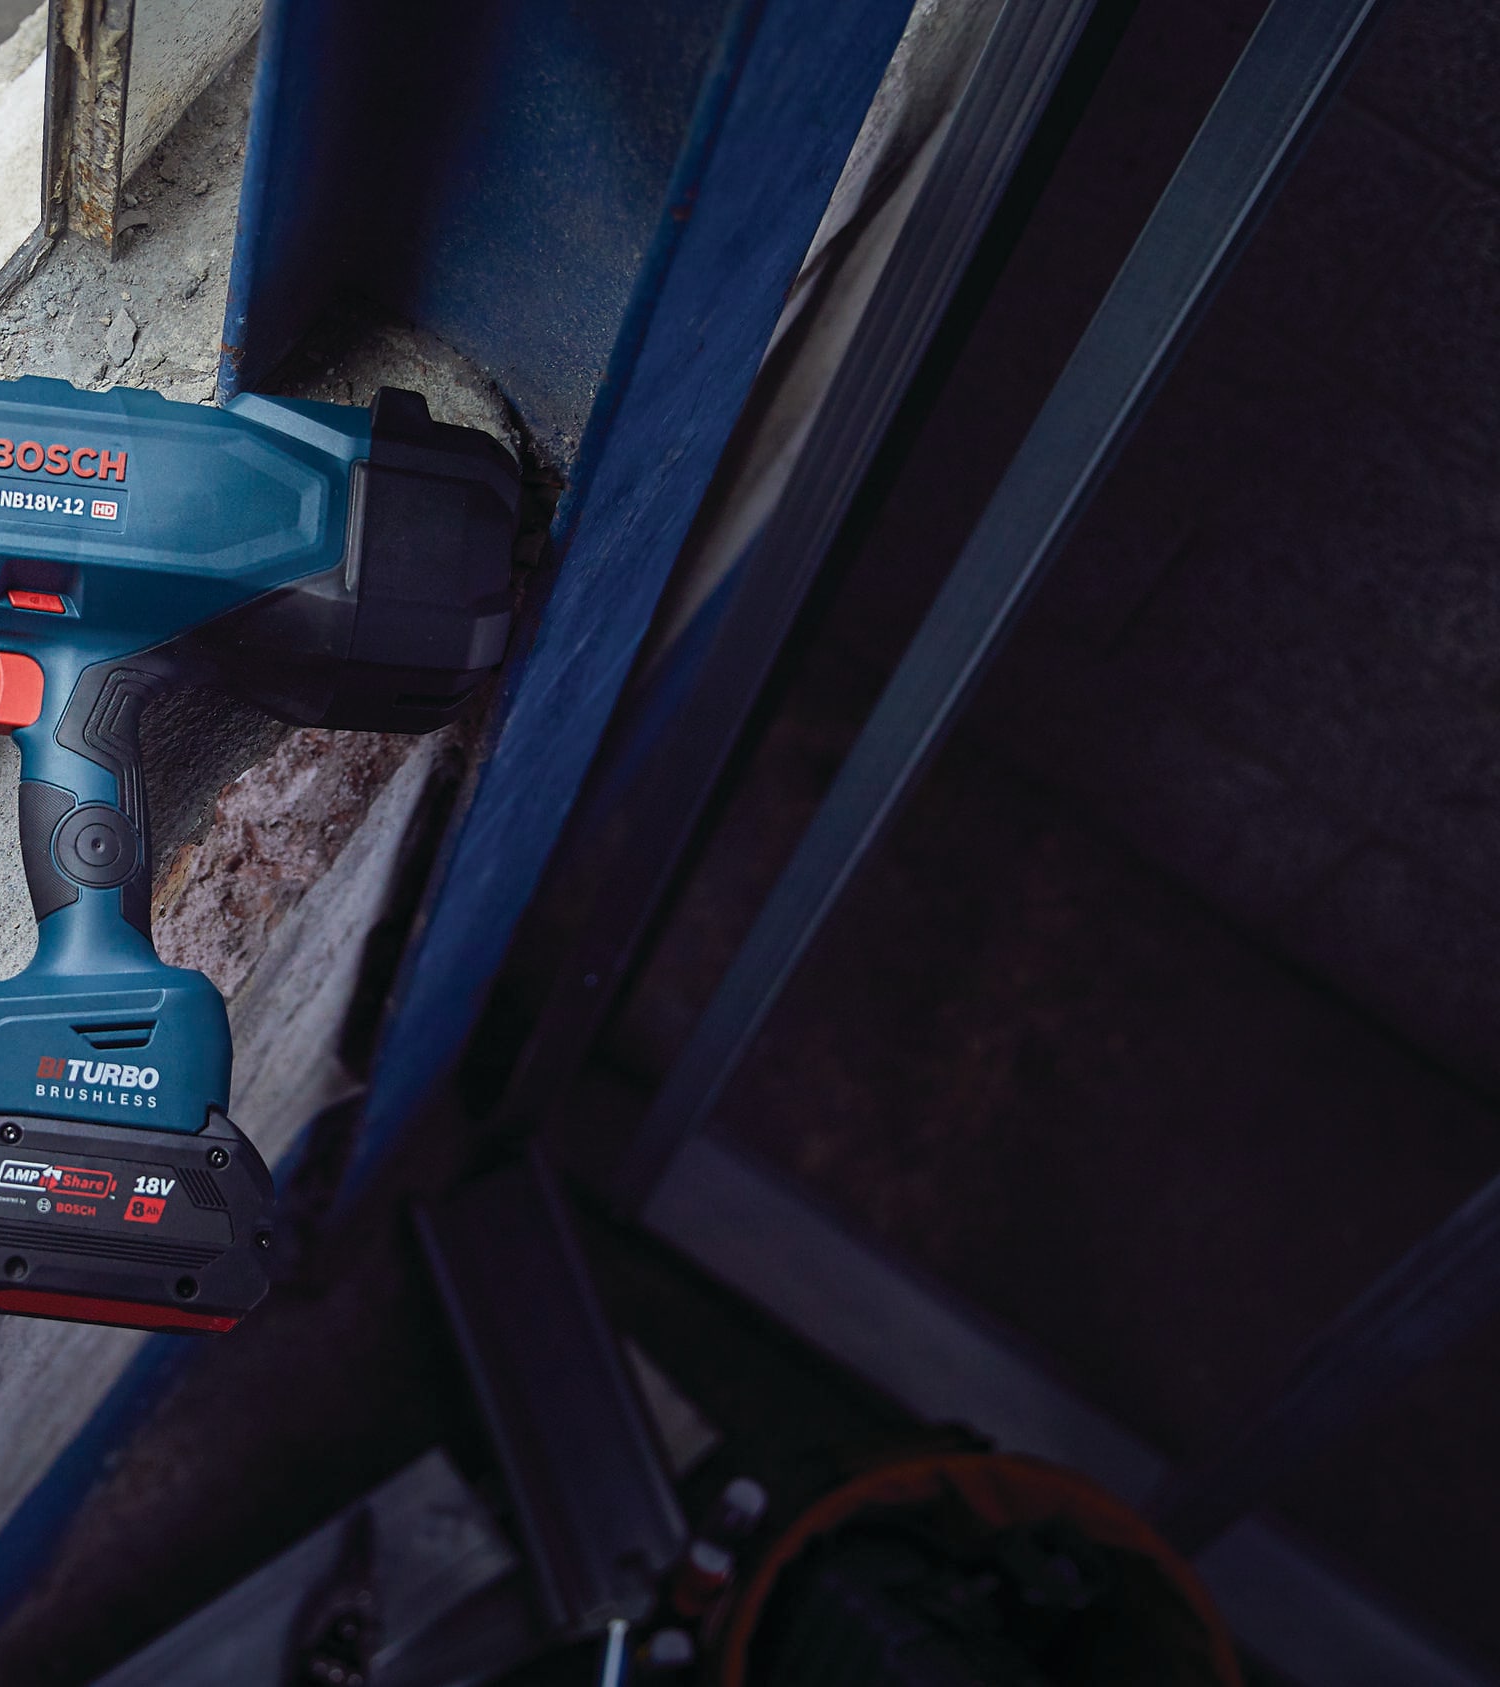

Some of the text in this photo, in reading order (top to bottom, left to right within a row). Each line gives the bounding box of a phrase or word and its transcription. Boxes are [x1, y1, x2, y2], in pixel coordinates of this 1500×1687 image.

[94, 504, 115, 517] HD
[35, 1084, 158, 1109] BRUSHLESS
[3, 1167, 105, 1191] AMP Share
[133, 1175, 176, 1197] 18V
[55, 1202, 97, 1217] BOSCH
